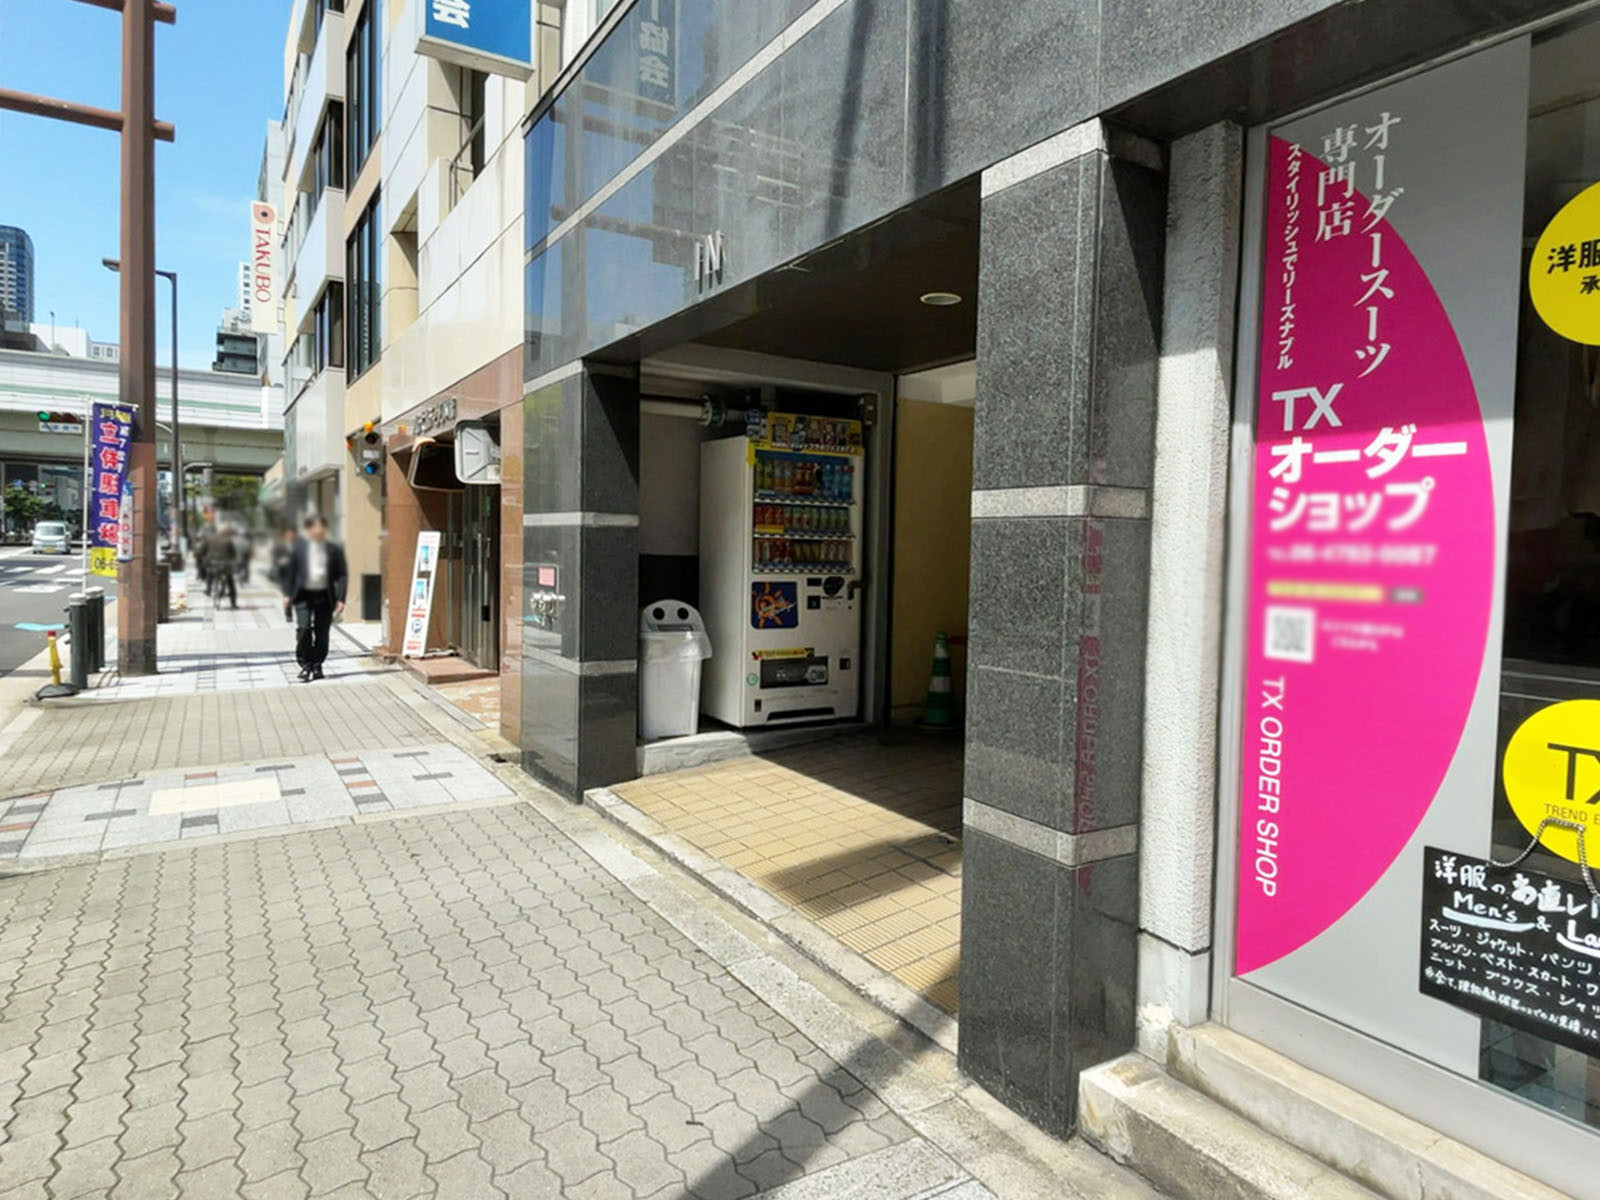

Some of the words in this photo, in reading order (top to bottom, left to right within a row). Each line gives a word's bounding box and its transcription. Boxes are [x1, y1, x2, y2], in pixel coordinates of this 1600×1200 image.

[1314, 122, 1358, 243] 専門店
[254, 227, 273, 303] TAKUBO
[1276, 142, 1302, 371] スタイリッシュでリーズナブル
[1353, 111, 1406, 380] オーダースーツ
[1272, 383, 1345, 432] TX
[1268, 423, 1468, 483] オーダー
[1267, 476, 1436, 532] ショップ
[1259, 677, 1286, 711] TX
[1257, 716, 1284, 811] ORDER
[1544, 803, 1588, 822] TREND
[1255, 819, 1280, 897] SHOP
[1453, 890, 1518, 923] Men's
